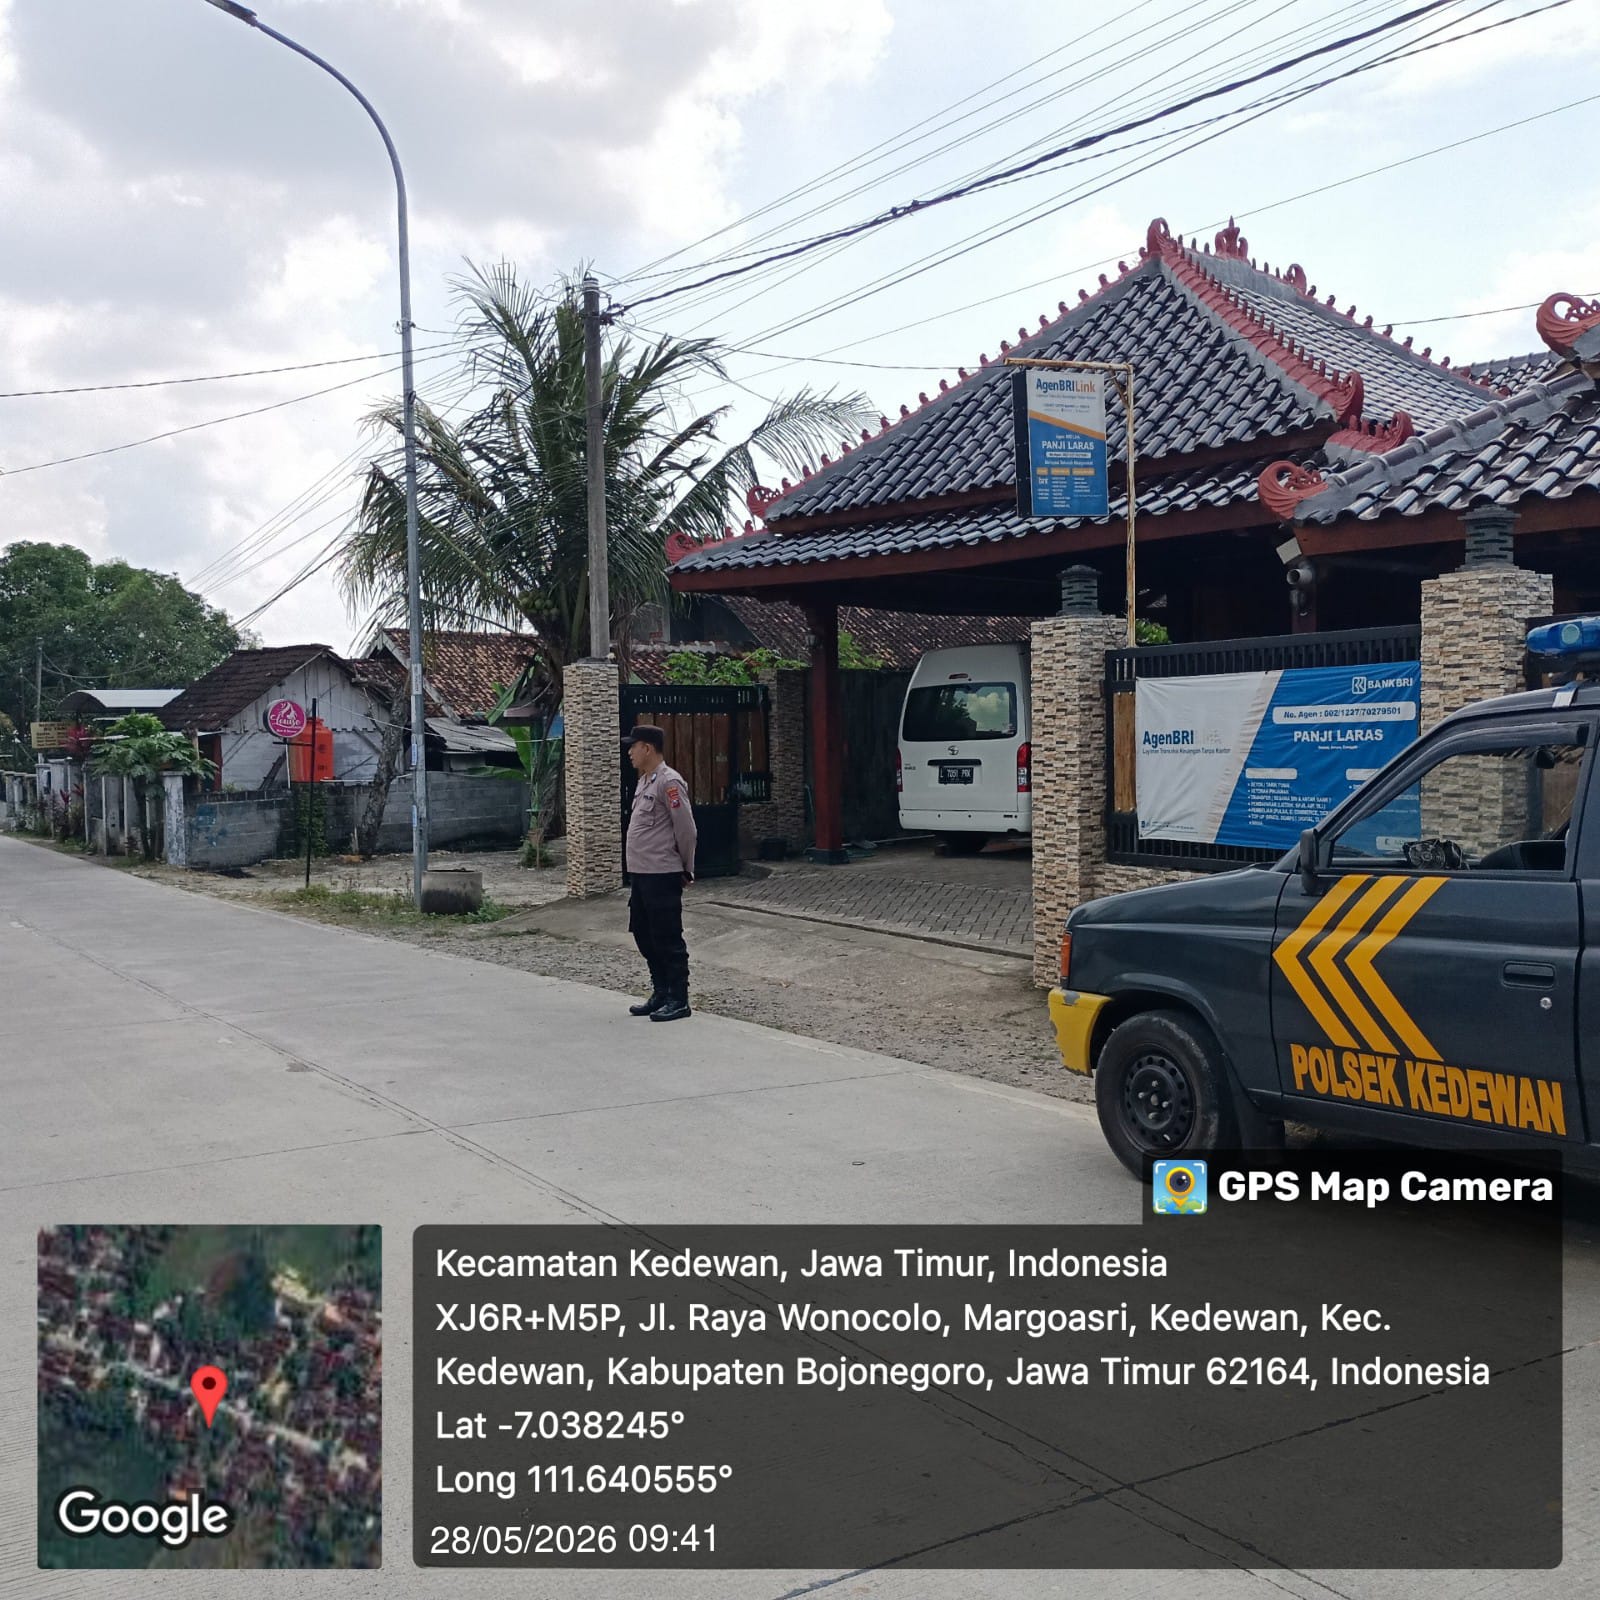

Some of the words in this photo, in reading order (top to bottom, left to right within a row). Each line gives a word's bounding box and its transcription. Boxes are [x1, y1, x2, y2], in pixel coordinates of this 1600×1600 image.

[1042, 440, 1066, 450] PANJI
[1068, 441, 1095, 450] LARAS
[1284, 711, 1297, 719] No.
[1298, 711, 1318, 720] Agen
[1142, 729, 1194, 749] AgenBRI
[1293, 730, 1333, 742] PANJI
[1337, 729, 1384, 742] LARAS
[1290, 1043, 1403, 1107] POLSEK
[1405, 1060, 1567, 1135] KEDEWAN
